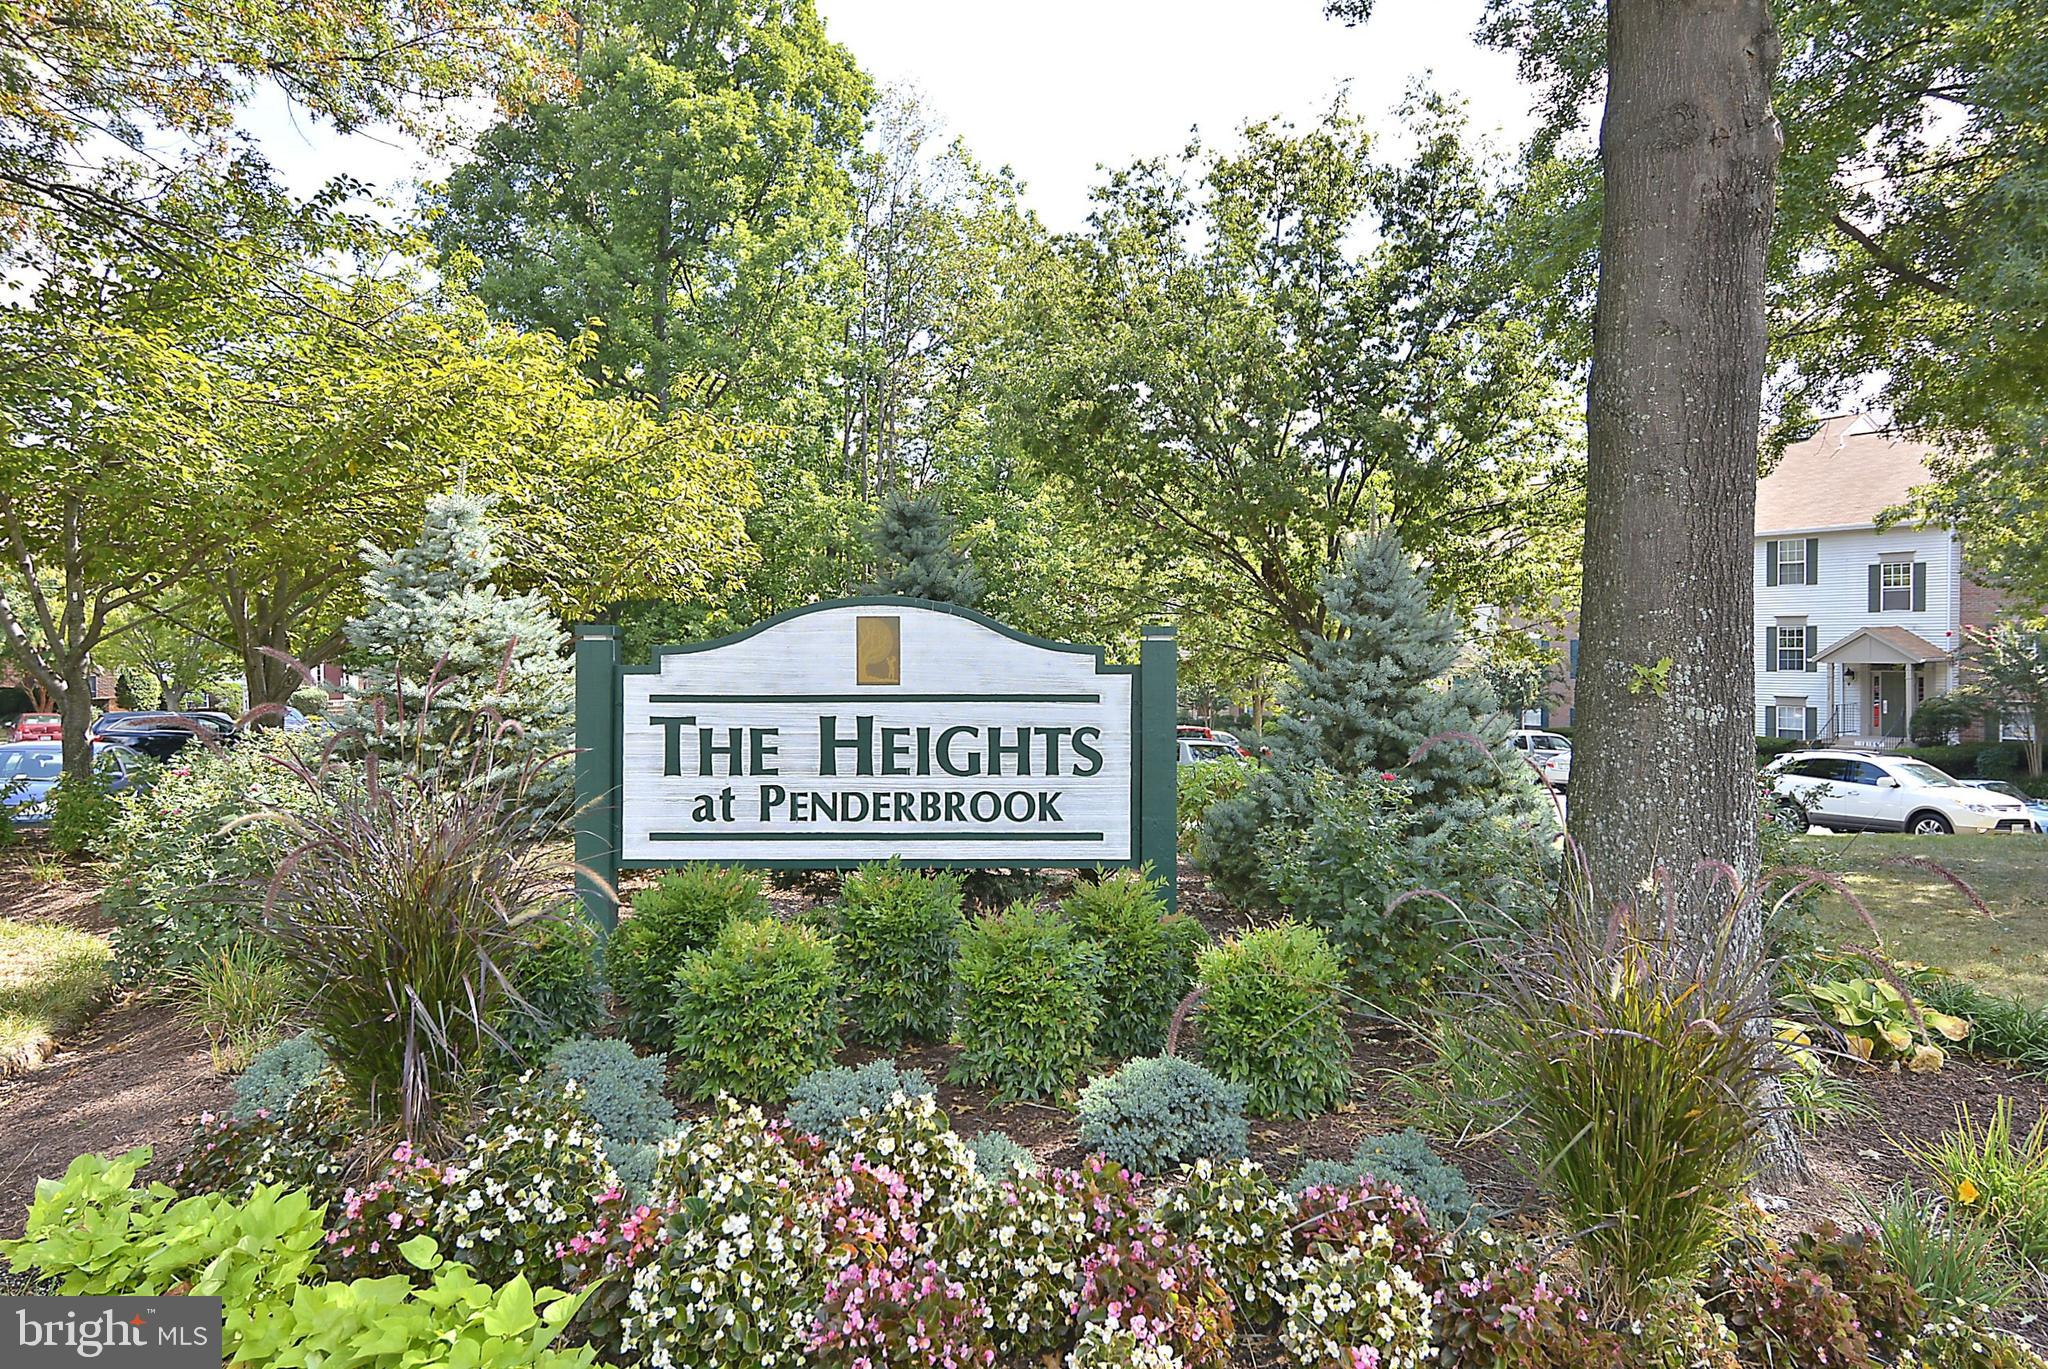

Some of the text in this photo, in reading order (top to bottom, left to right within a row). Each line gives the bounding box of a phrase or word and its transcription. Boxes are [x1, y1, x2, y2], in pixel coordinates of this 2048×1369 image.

[649, 715, 1104, 778] THE HEIGHTS
[691, 784, 1064, 823] at PENDERBROOK
